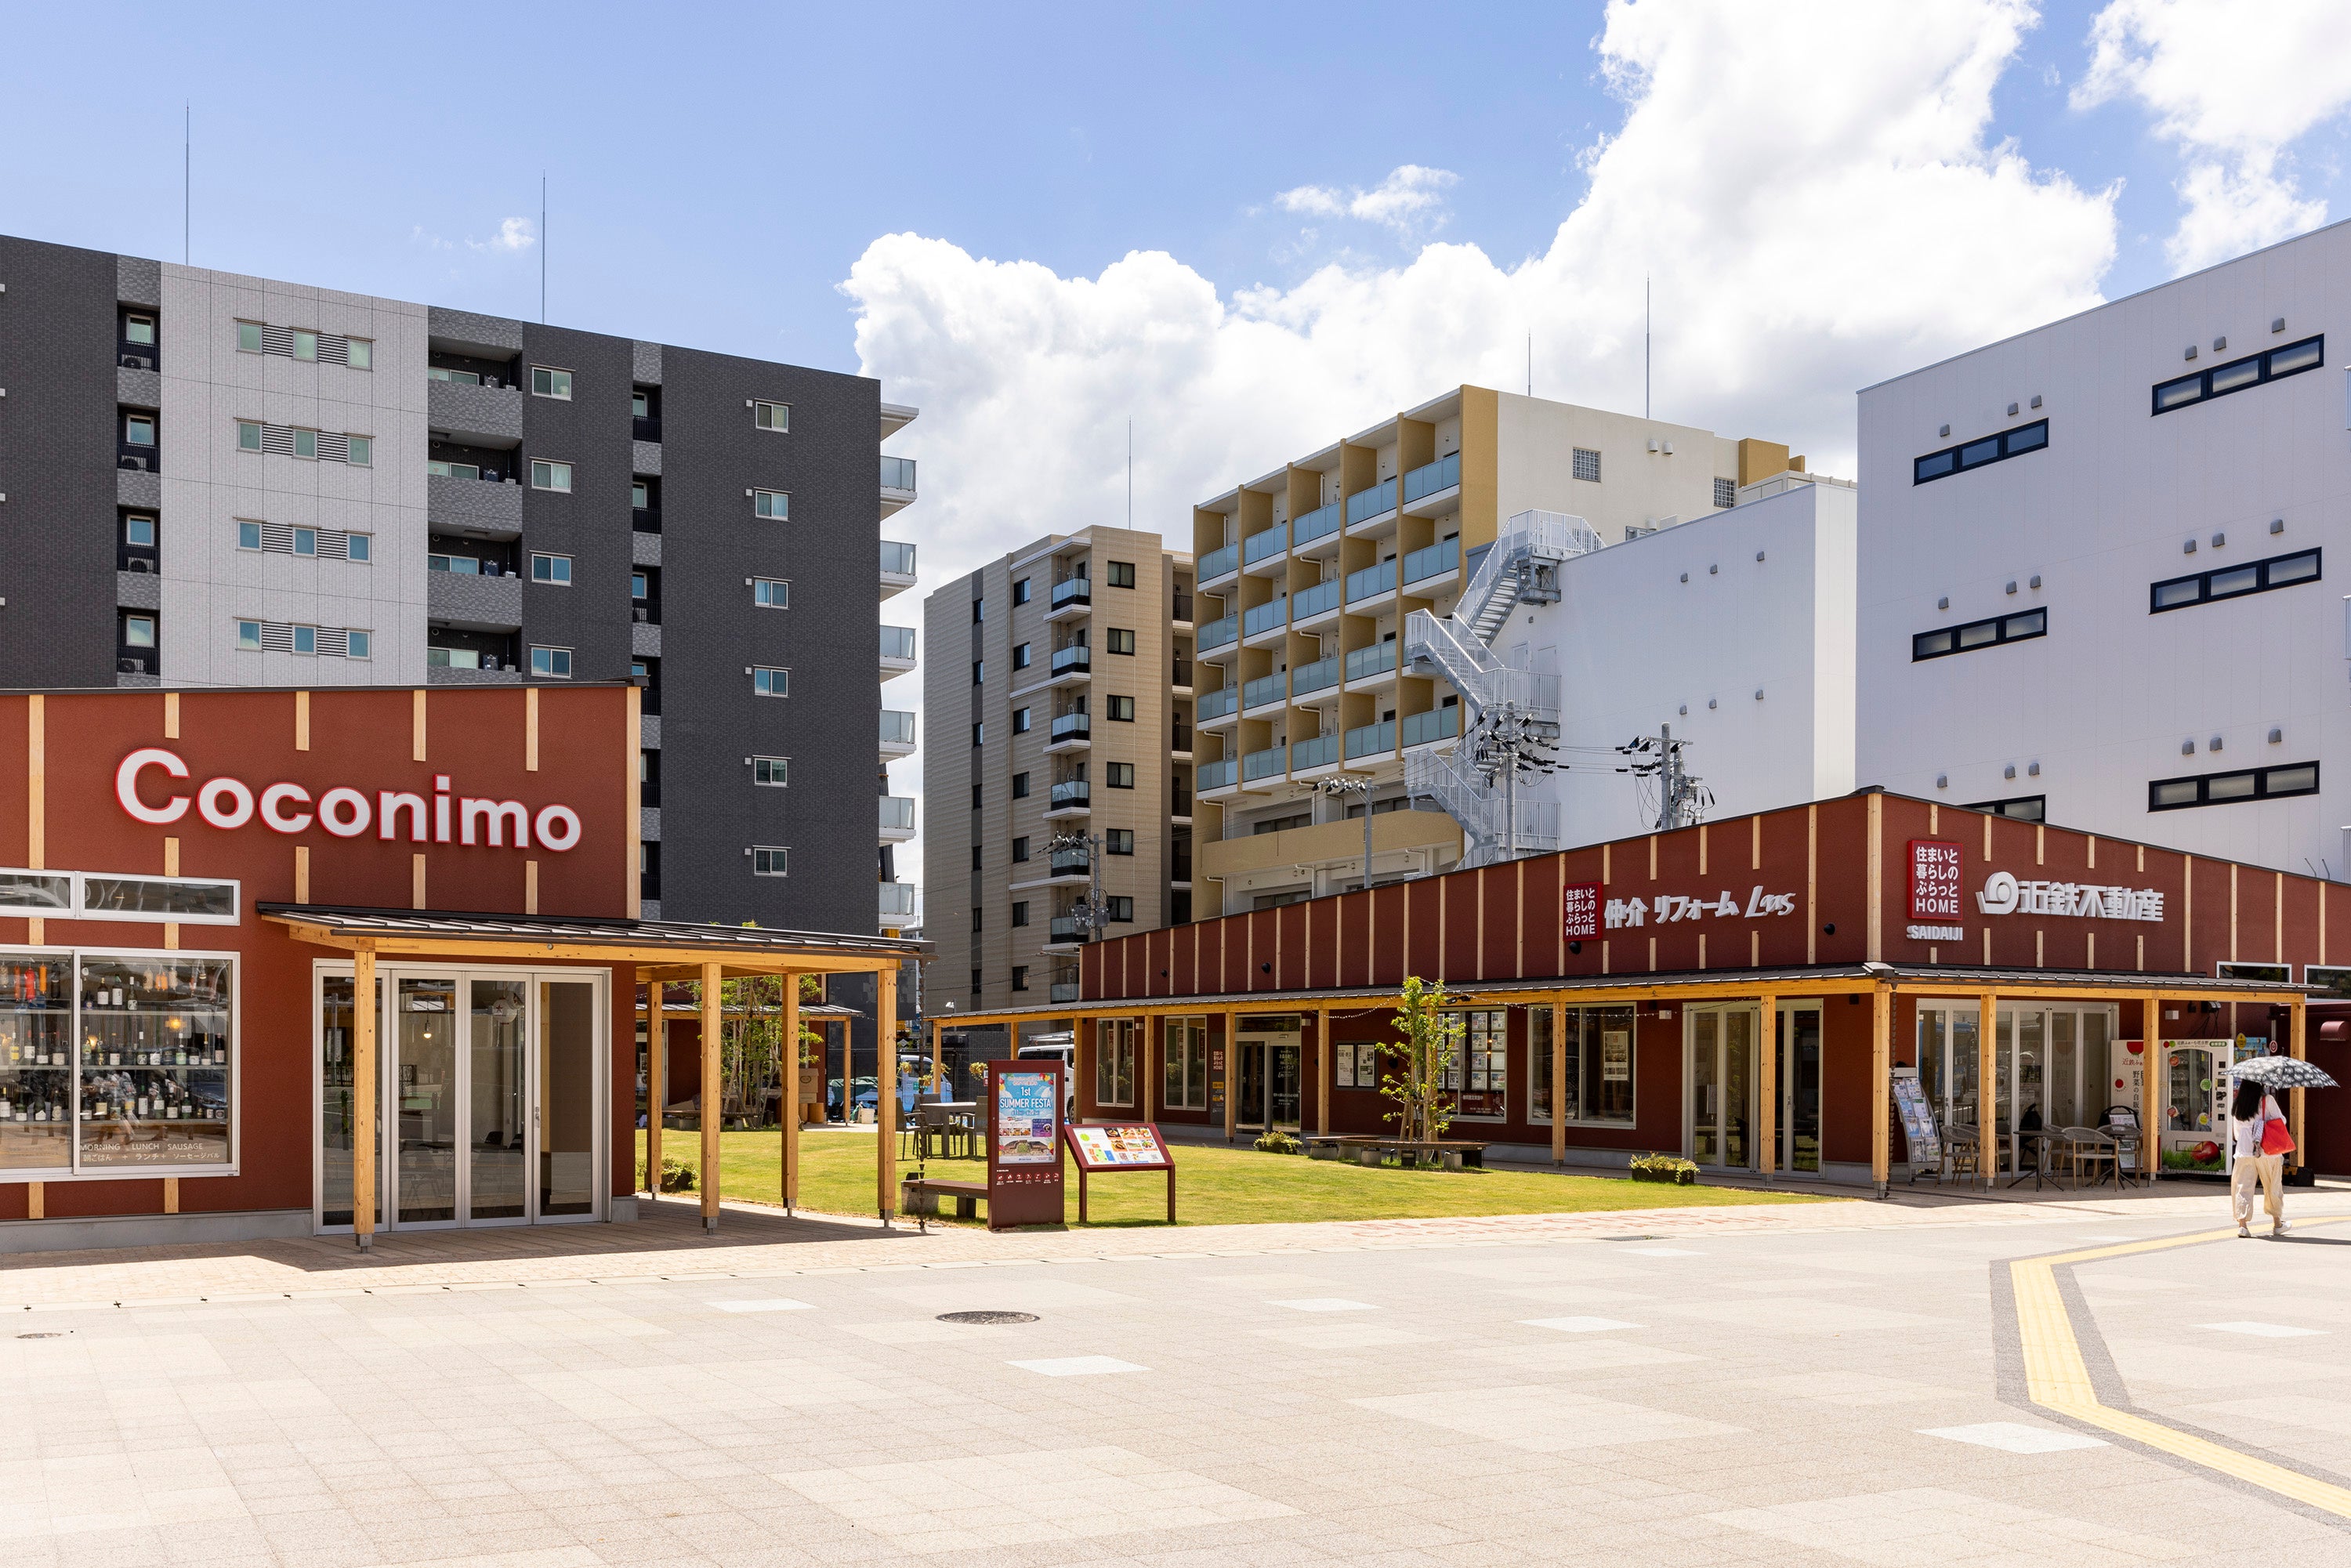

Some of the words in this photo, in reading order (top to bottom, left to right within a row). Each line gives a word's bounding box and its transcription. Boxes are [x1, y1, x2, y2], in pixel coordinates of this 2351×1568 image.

[114, 747, 582, 853] Coconimo
[1915, 846, 1958, 864] 住まいと
[1915, 864, 1958, 881] 暮らしの
[1566, 887, 1596, 901] 住まいと
[1915, 881, 1958, 898] ぷらっと
[1566, 900, 1596, 913] 暮らしの
[1915, 898, 1958, 914] HOME
[2016, 881, 2164, 922] 近鉄不動産
[1604, 896, 1649, 929] 仲介
[1654, 890, 1740, 924] リフォーム
[1566, 912, 1596, 925] ぷらっと
[1566, 925, 1596, 936] HOME
[1907, 925, 1963, 941] SAIDAIJI
[1020, 1087, 1031, 1096] 1st
[999, 1098, 1030, 1108] SUMMER
[1031, 1098, 1052, 1108] FESTA
[80, 1143, 121, 1151] MORNING
[82, 1153, 113, 1162] 朝ごはん
